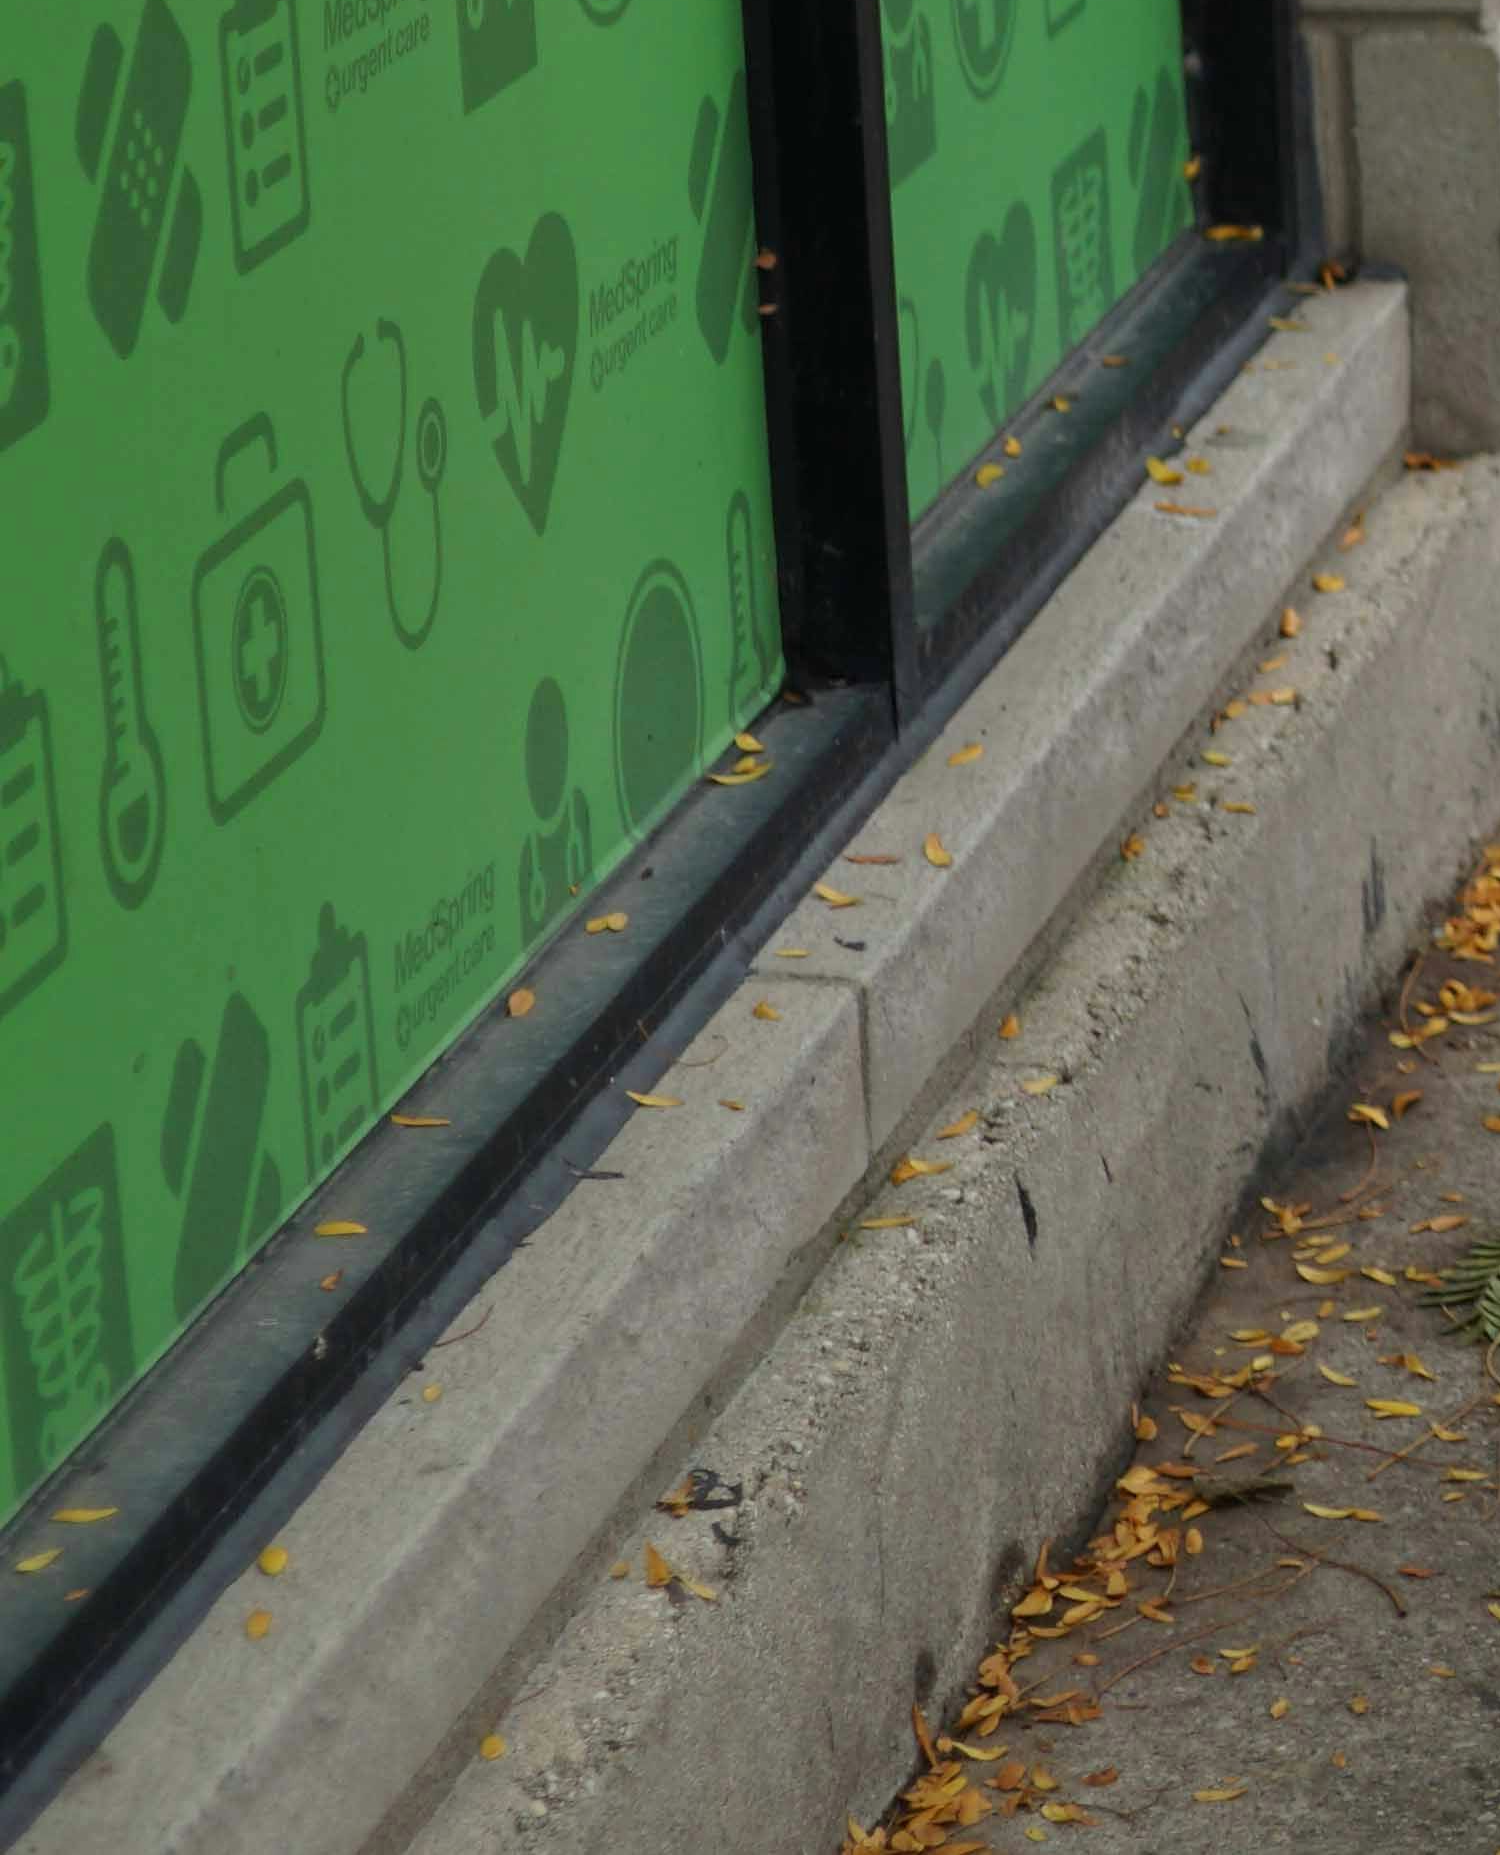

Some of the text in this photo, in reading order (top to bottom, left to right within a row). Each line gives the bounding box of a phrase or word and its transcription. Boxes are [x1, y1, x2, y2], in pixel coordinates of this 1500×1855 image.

[342, 12, 430, 96] urgent care
[590, 235, 678, 338] MedSpring
[394, 861, 495, 994] MedSpring
